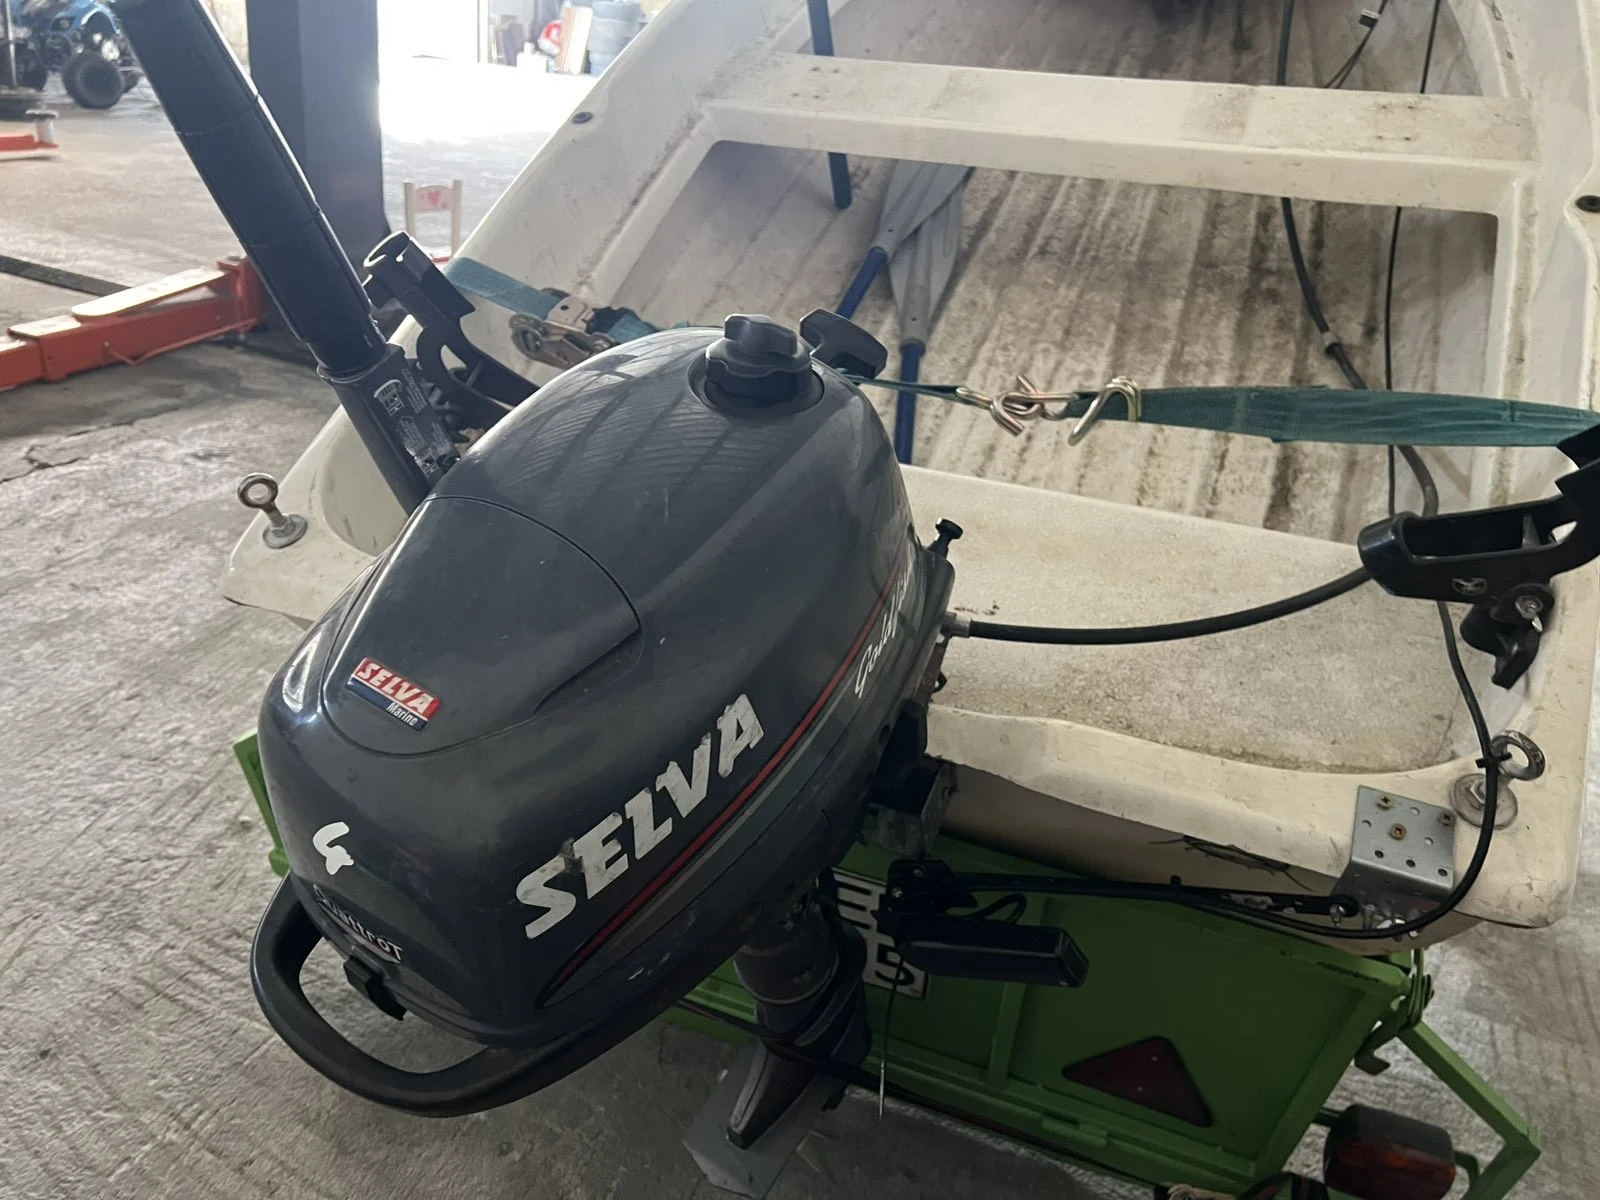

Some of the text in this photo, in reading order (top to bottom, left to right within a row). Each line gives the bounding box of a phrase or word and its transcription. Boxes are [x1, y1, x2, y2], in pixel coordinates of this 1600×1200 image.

[356, 662, 434, 714] SELVA
[386, 701, 418, 726] Marine
[515, 693, 764, 939] SELVA
